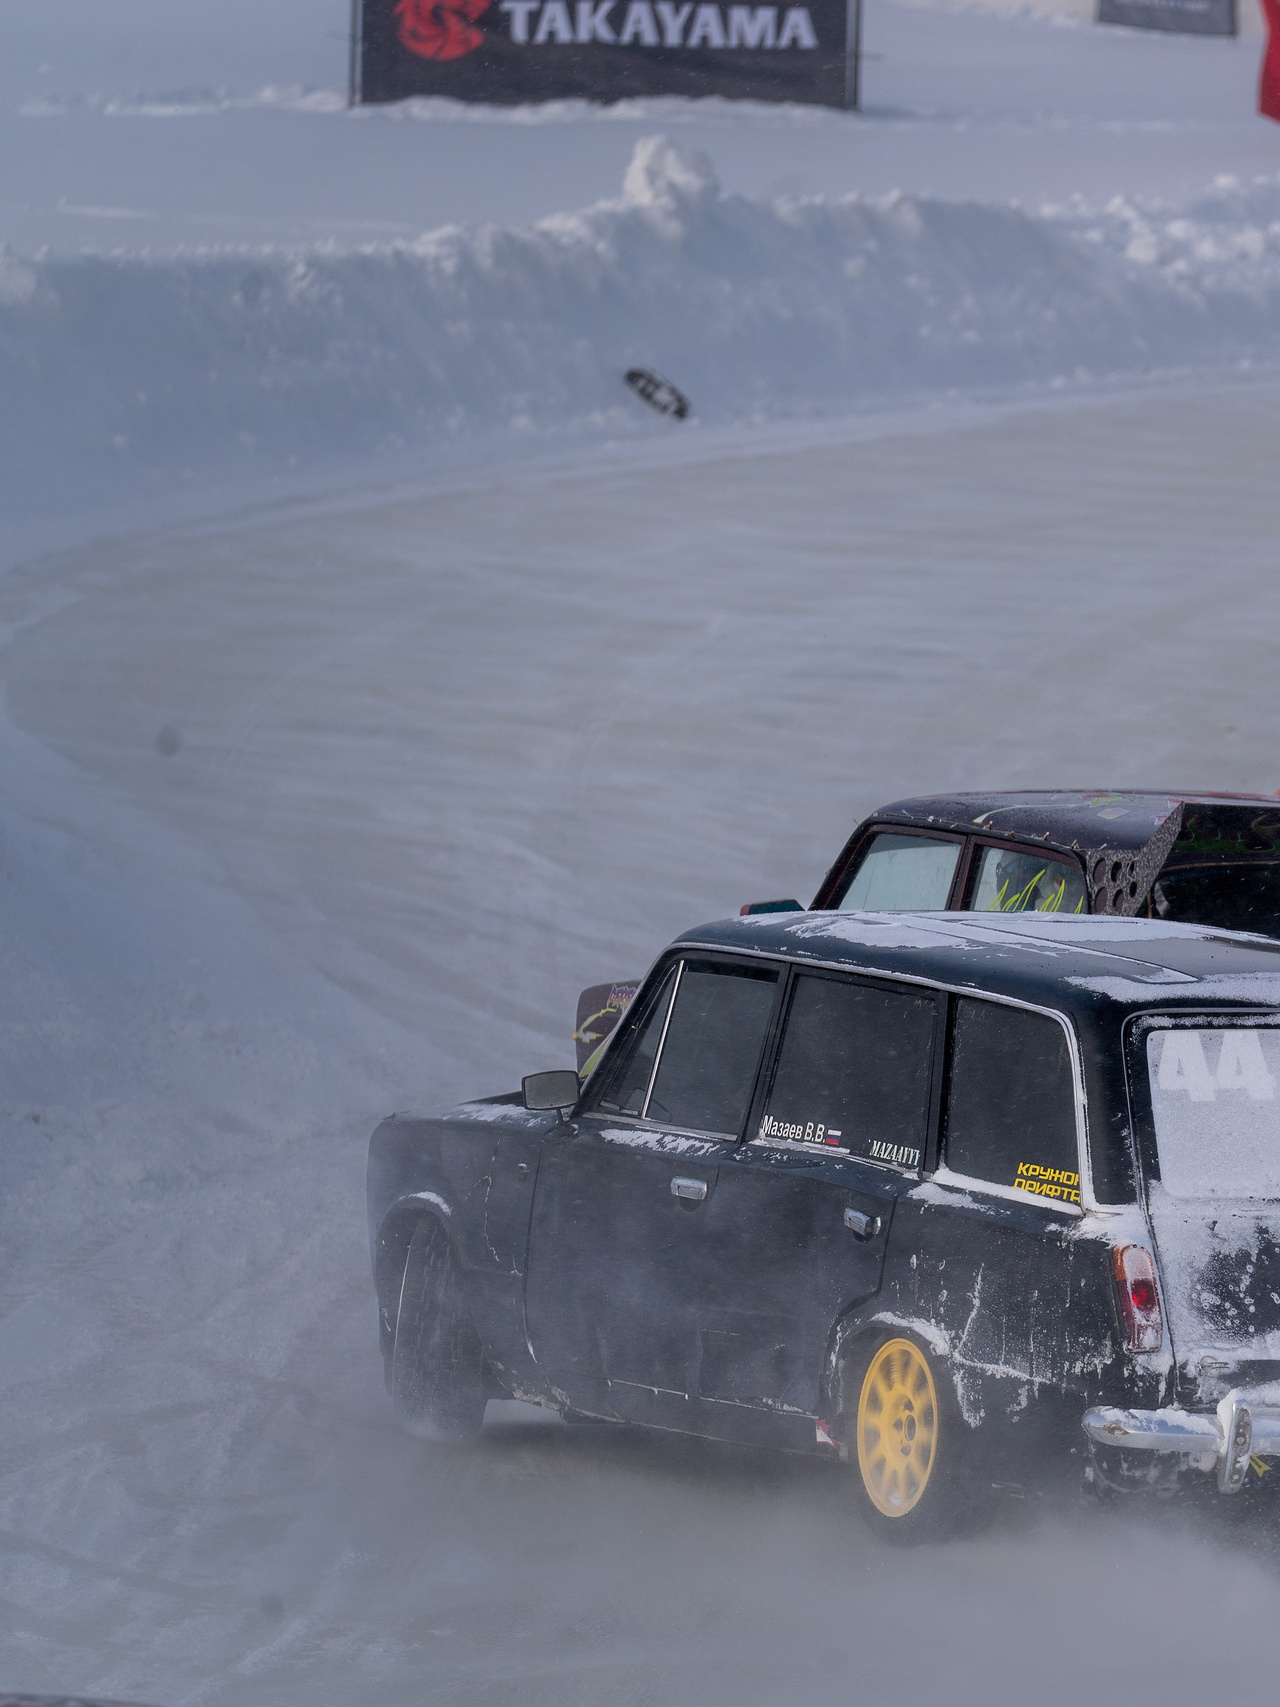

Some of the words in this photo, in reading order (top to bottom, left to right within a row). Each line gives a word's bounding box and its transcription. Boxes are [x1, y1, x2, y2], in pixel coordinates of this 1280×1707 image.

[500, 0, 819, 50] TAKAYAMA
[1157, 1031, 1276, 1102] 44
[762, 1115, 803, 1140] Мазаев
